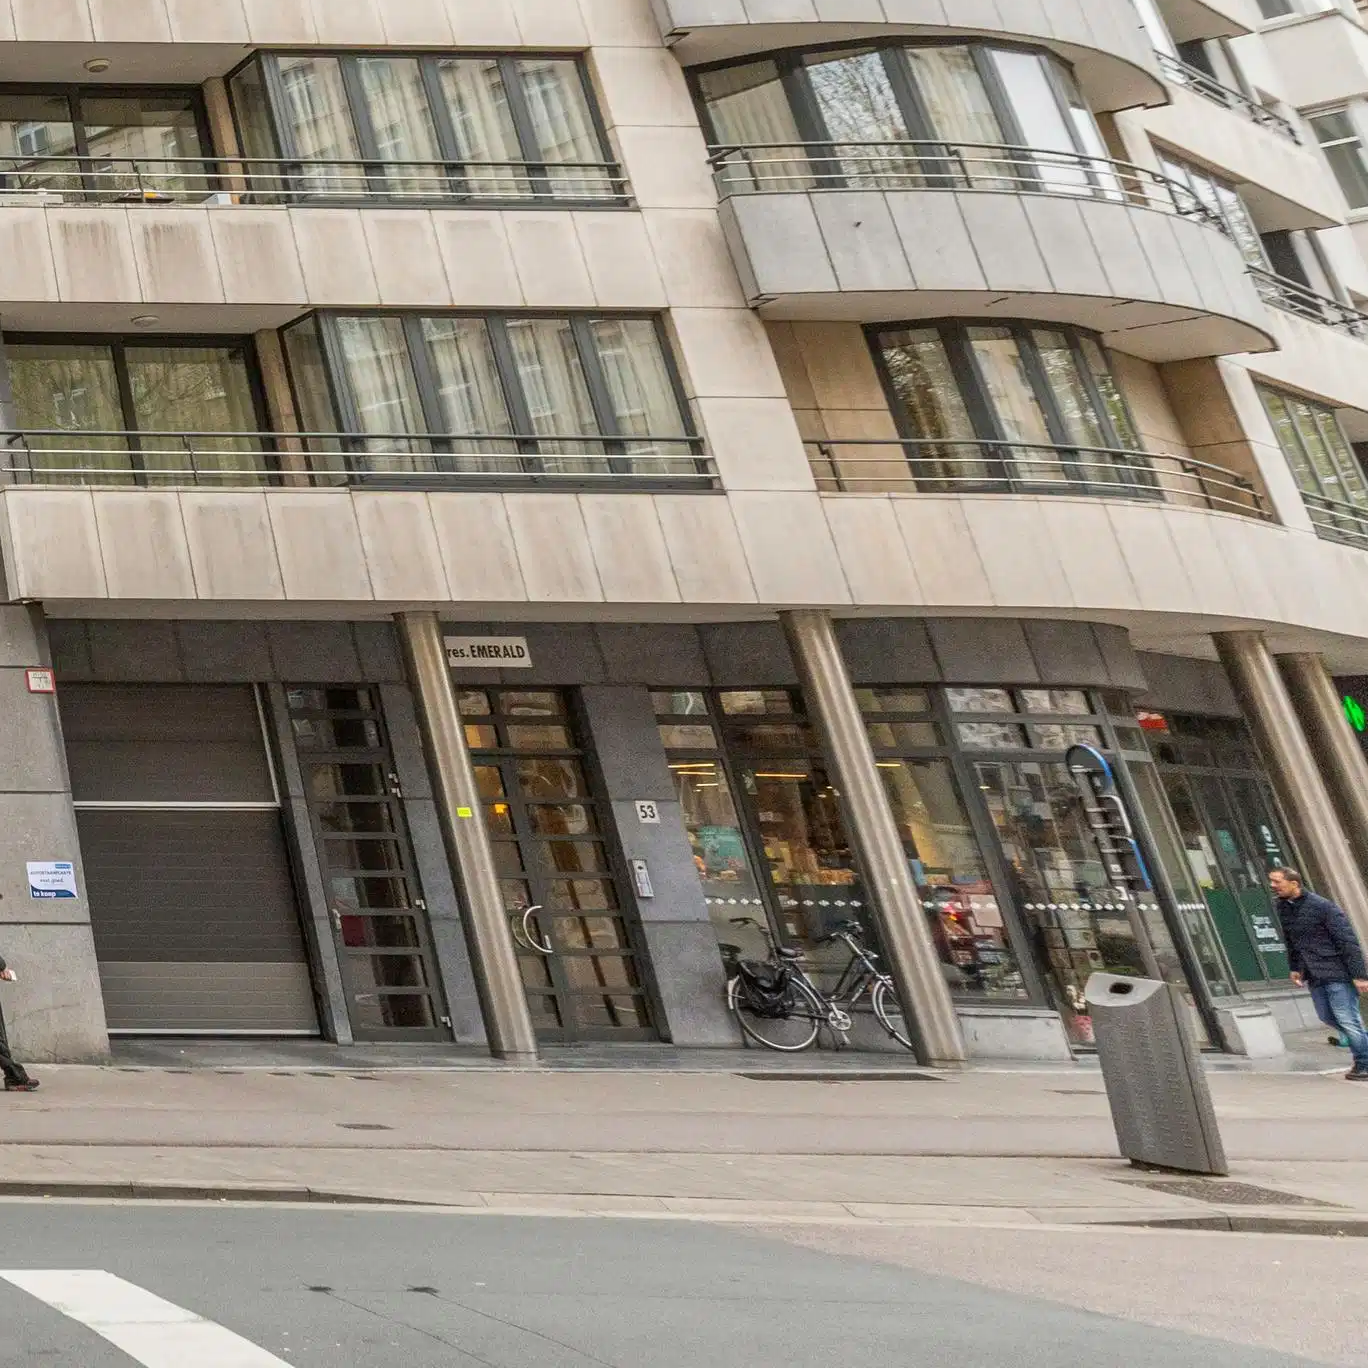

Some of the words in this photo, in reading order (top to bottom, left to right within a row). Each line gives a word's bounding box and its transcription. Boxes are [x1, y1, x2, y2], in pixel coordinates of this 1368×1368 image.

[447, 648, 469, 658] res.
[470, 645, 525, 658] EMERALD
[640, 805, 656, 818] 53
